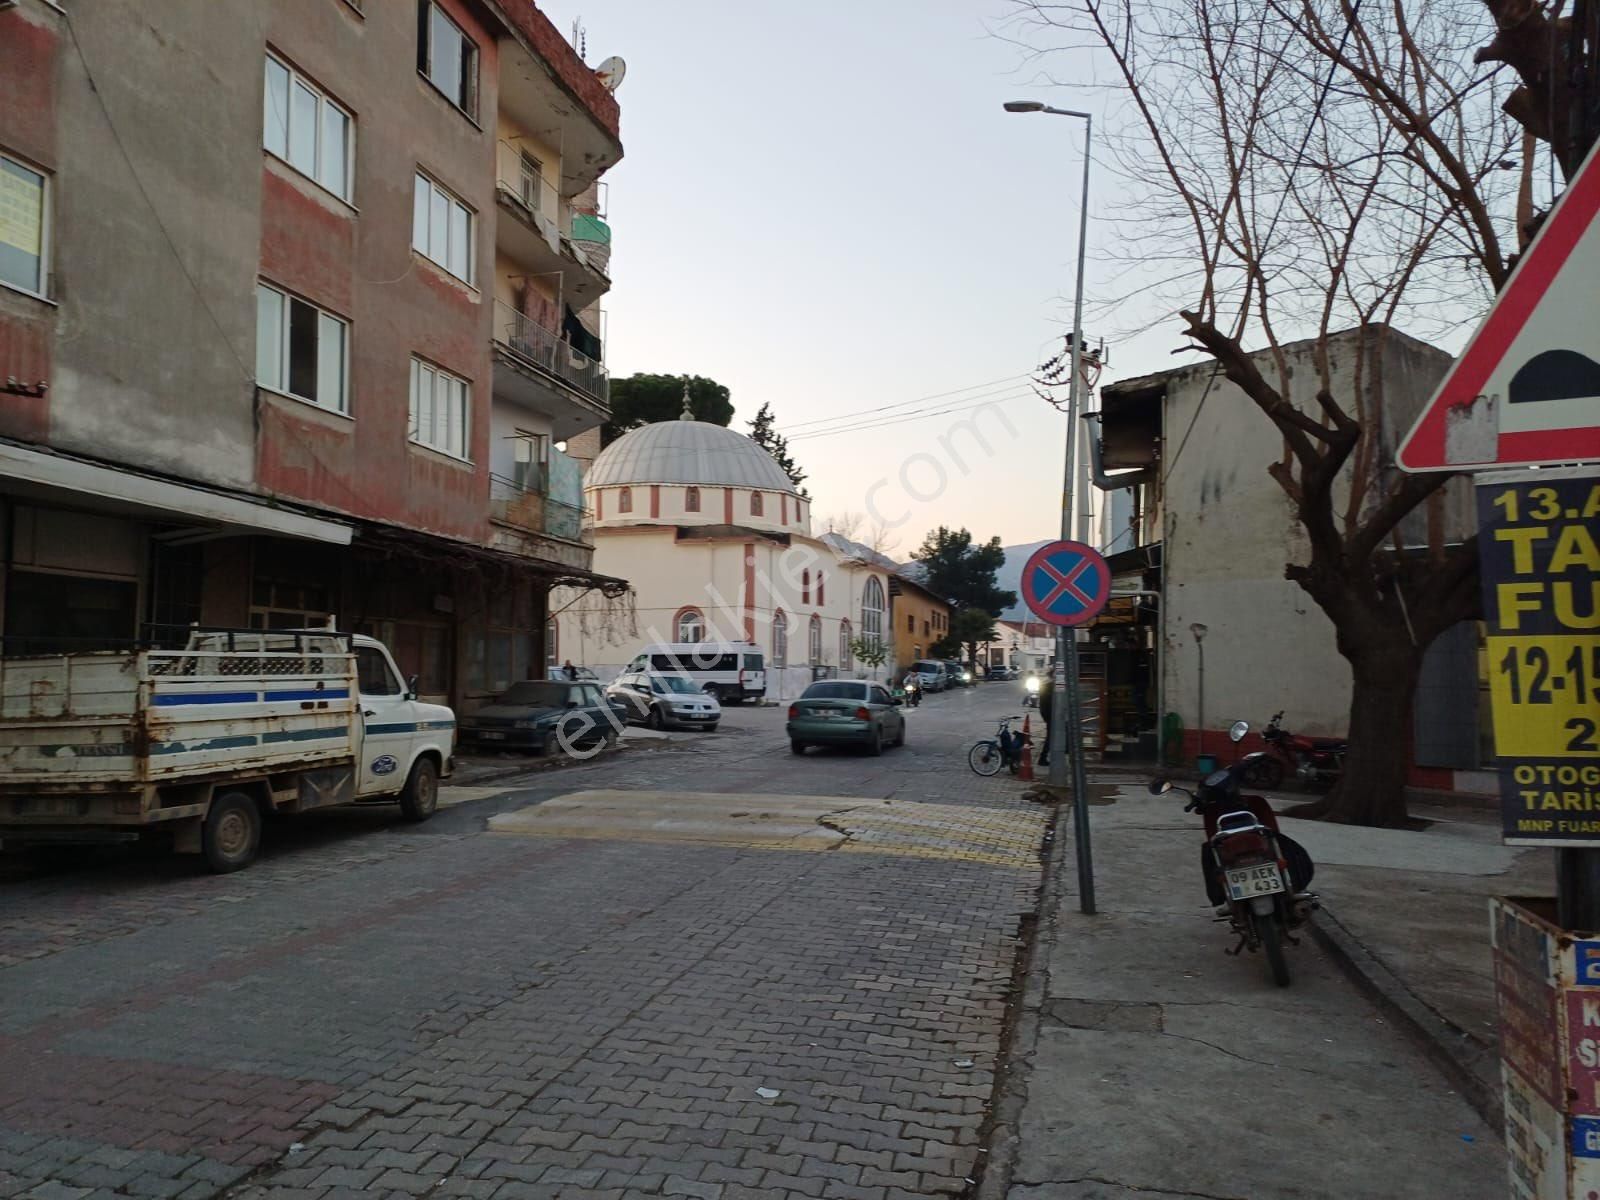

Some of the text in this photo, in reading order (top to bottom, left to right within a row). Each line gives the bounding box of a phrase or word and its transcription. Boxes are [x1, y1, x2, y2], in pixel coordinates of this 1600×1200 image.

[1494, 524, 1600, 574] TA
[1496, 580, 1600, 630] FU
[1565, 718, 1599, 752] 2
[1513, 765, 1600, 786] OTOG
[1517, 819, 1553, 832] MNP
[1231, 871, 1248, 884] 09
[1255, 878, 1280, 891] 433
